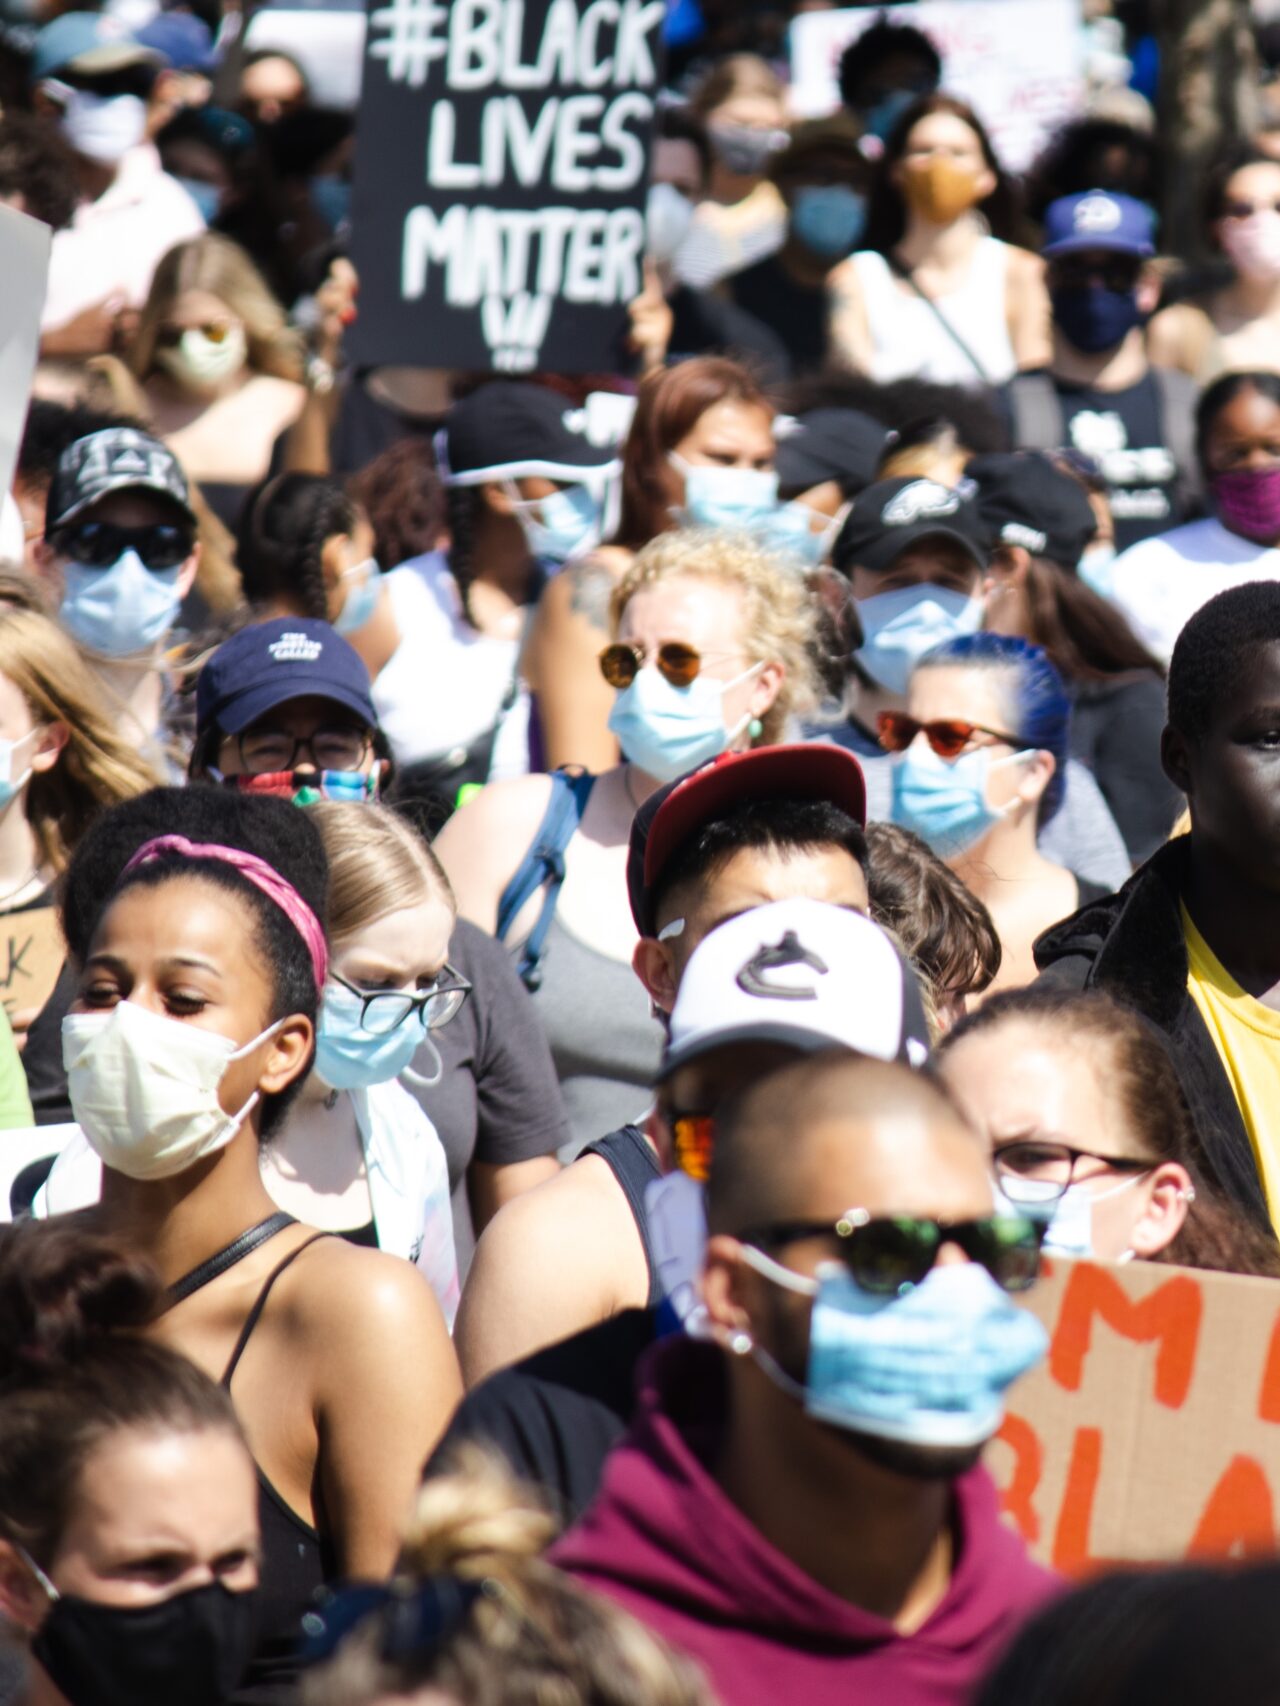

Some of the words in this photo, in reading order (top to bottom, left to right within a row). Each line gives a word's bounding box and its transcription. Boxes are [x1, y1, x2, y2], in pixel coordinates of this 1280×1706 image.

[369, 0, 665, 89] #BLACK
[427, 92, 653, 191] LIVES
[402, 204, 646, 308] MATTER
